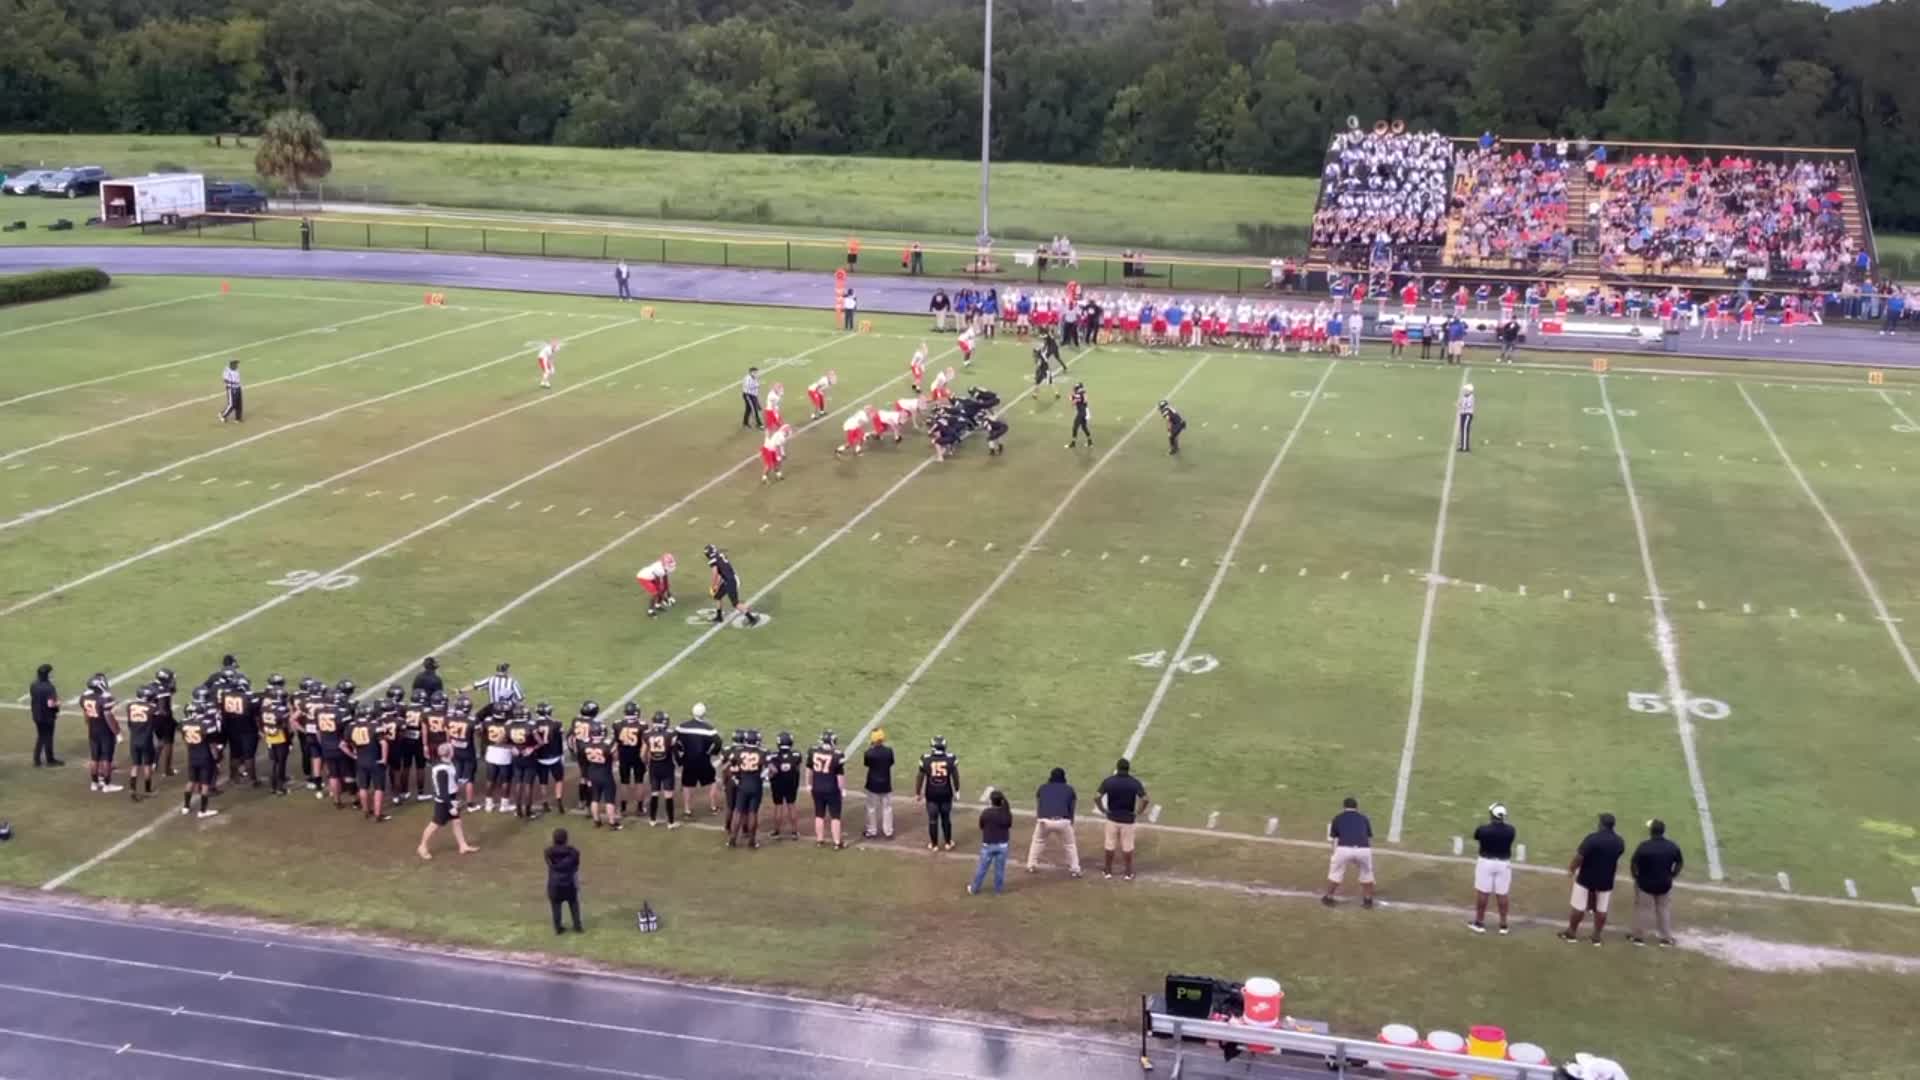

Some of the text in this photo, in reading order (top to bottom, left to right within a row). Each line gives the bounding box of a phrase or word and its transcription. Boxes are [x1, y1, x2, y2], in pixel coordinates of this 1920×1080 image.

[1128, 650, 1219, 674] 40
[1627, 691, 1731, 720] 50
[619, 727, 639, 747] 45
[649, 735, 665, 753] 13
[739, 752, 759, 771] 32
[811, 753, 831, 773] 57
[929, 761, 946, 777] 15
